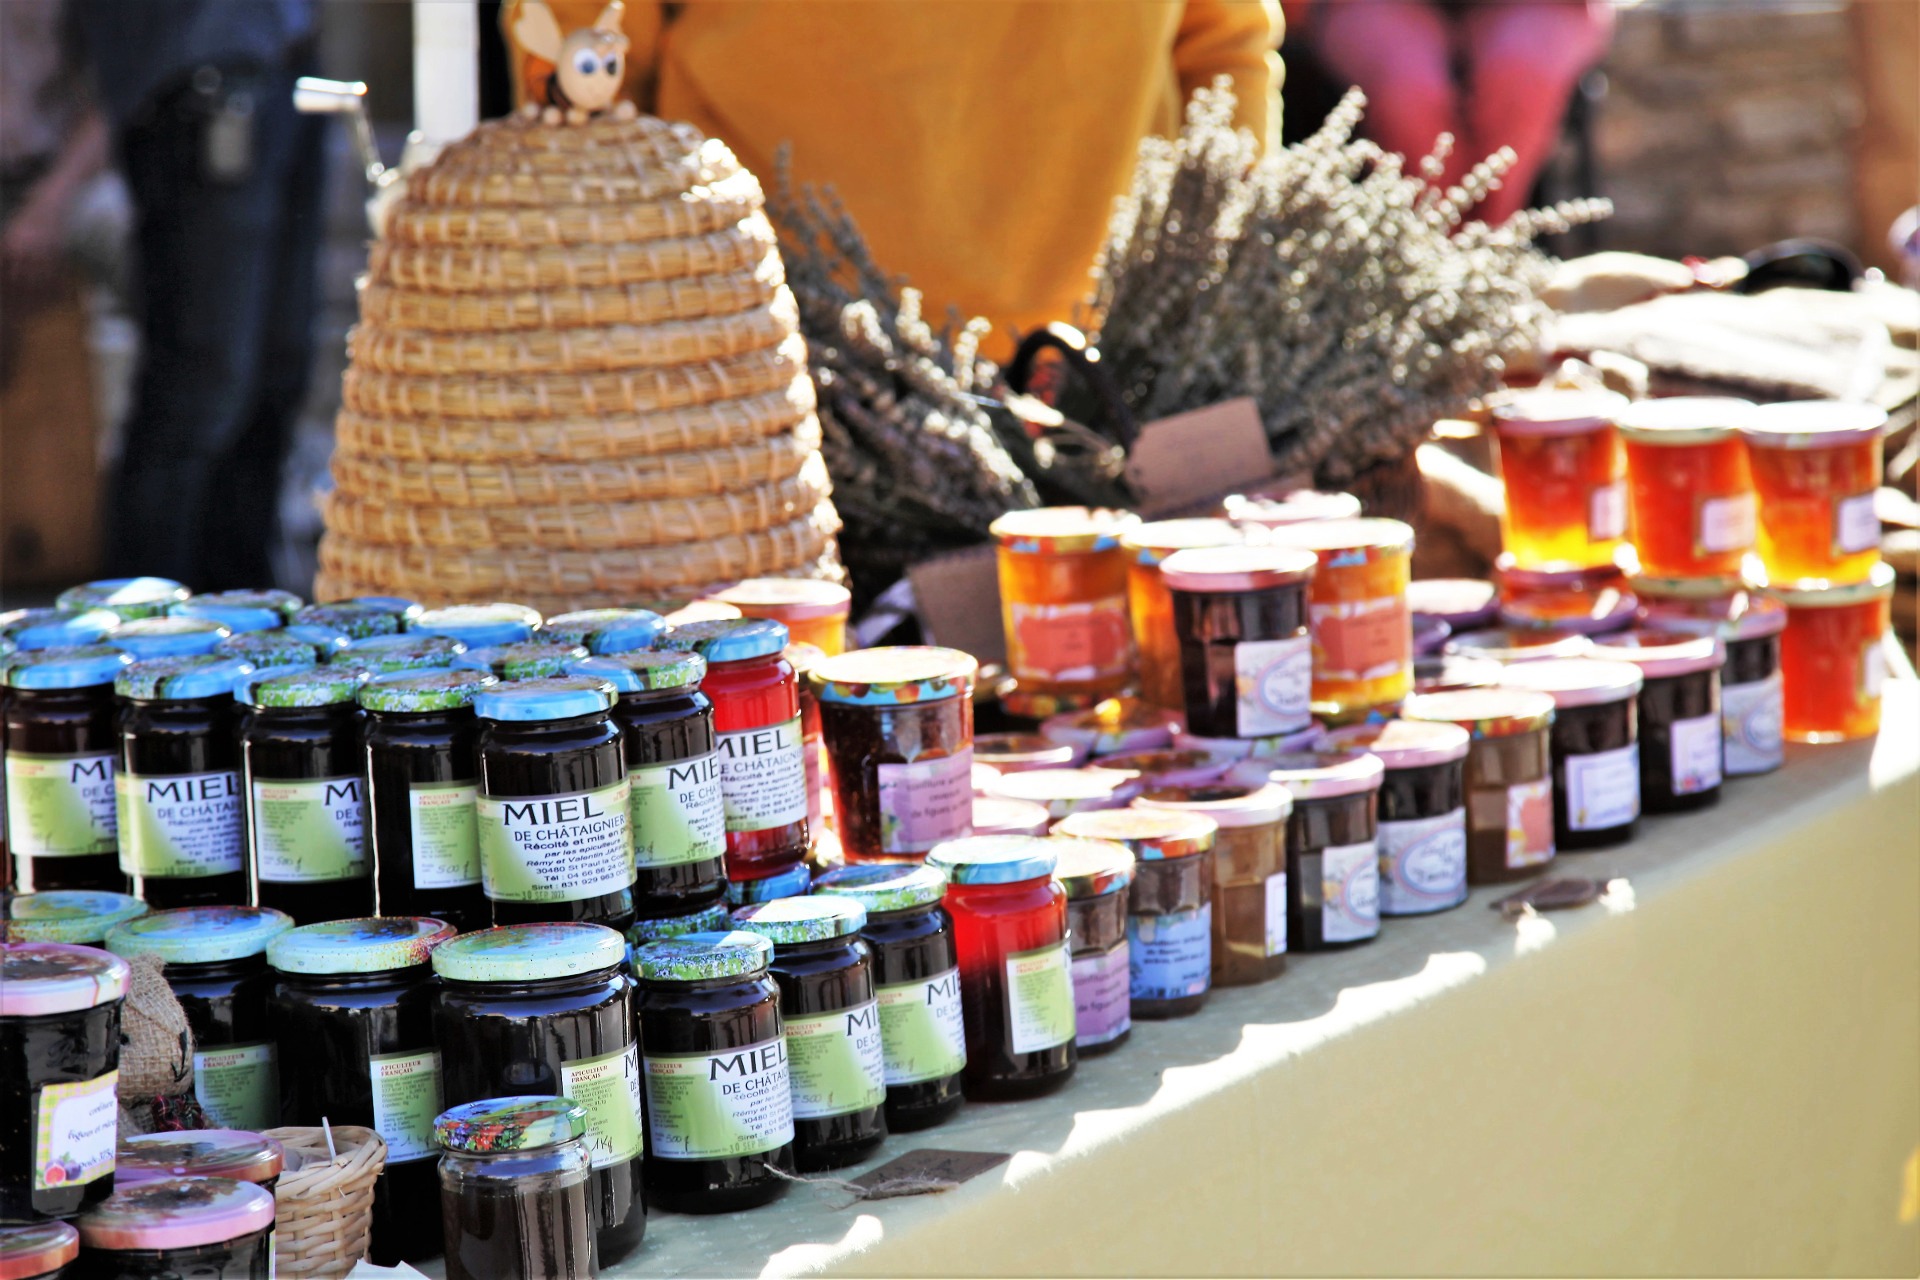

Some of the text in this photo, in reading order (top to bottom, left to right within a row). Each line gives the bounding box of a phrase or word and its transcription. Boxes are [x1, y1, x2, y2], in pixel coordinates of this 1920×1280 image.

[148, 775, 240, 803] MIEL
[502, 796, 604, 826] MIEL
[514, 831, 532, 842] DE
[536, 814, 624, 840] CHÂTAIGNIER
[524, 840, 568, 850] Récolté
[573, 838, 584, 846] et
[587, 834, 605, 844] mis
[544, 850, 561, 858] par
[568, 852, 604, 862] Valentin
[580, 860, 600, 869] Paul
[568, 872, 579, 880] 04
[582, 876, 598, 886] 929
[381, 1060, 421, 1071] APICULTEUR
[708, 1042, 786, 1081] MIEL
[381, 1068, 414, 1077] FRANÇAIS
[571, 1066, 608, 1078] APICULTEUR
[572, 1073, 600, 1083] FRANÇAIS
[722, 1082, 740, 1095] DE
[731, 1088, 770, 1102] Récolté
[750, 1100, 763, 1108] par
[732, 1108, 758, 1118] Rémy
[738, 1132, 758, 1142] Siret
